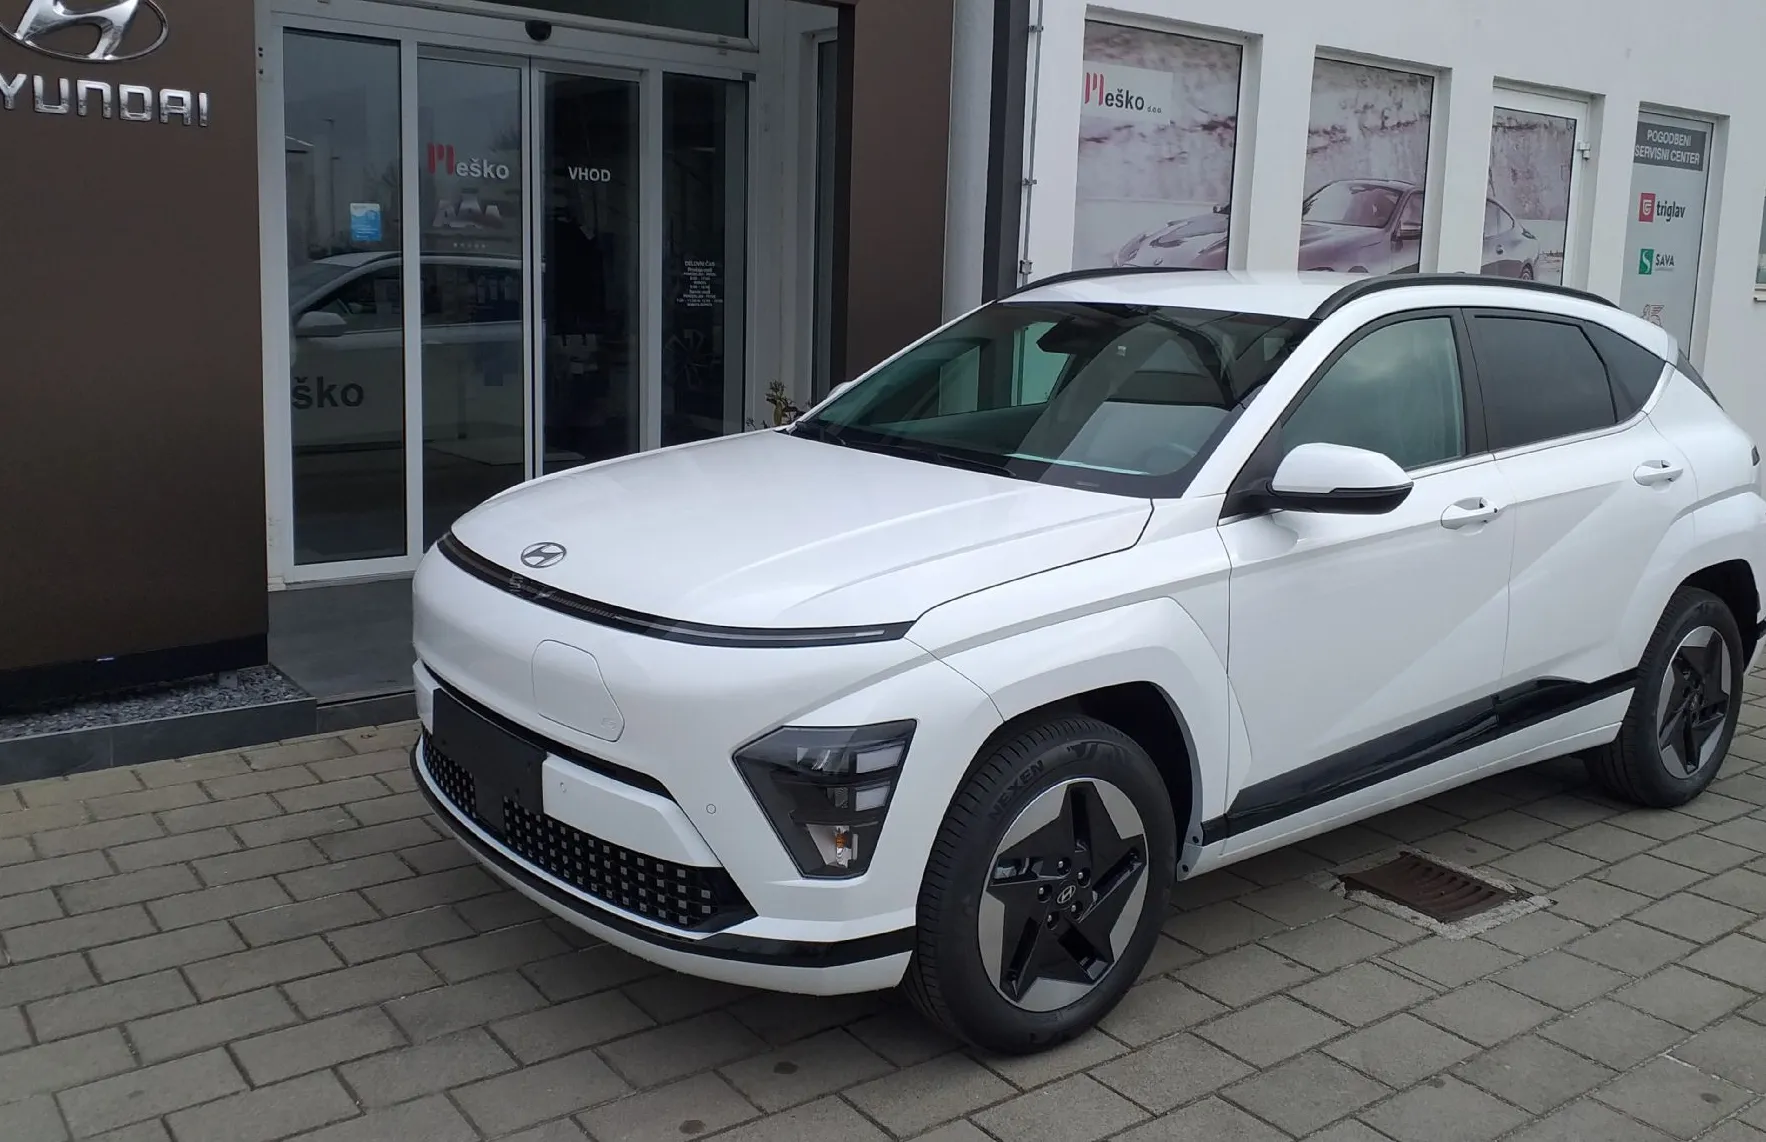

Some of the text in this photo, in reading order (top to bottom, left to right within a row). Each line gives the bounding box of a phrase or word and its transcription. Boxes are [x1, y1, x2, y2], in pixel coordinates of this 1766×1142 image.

[1646, 129, 1692, 148] POGODBENI
[1634, 144, 1701, 166] SERVISNI CENTER
[568, 165, 611, 183] VHOD
[1656, 201, 1686, 223] triglav
[1655, 253, 1675, 267] SAVA
[987, 759, 1045, 819] NEXEN
